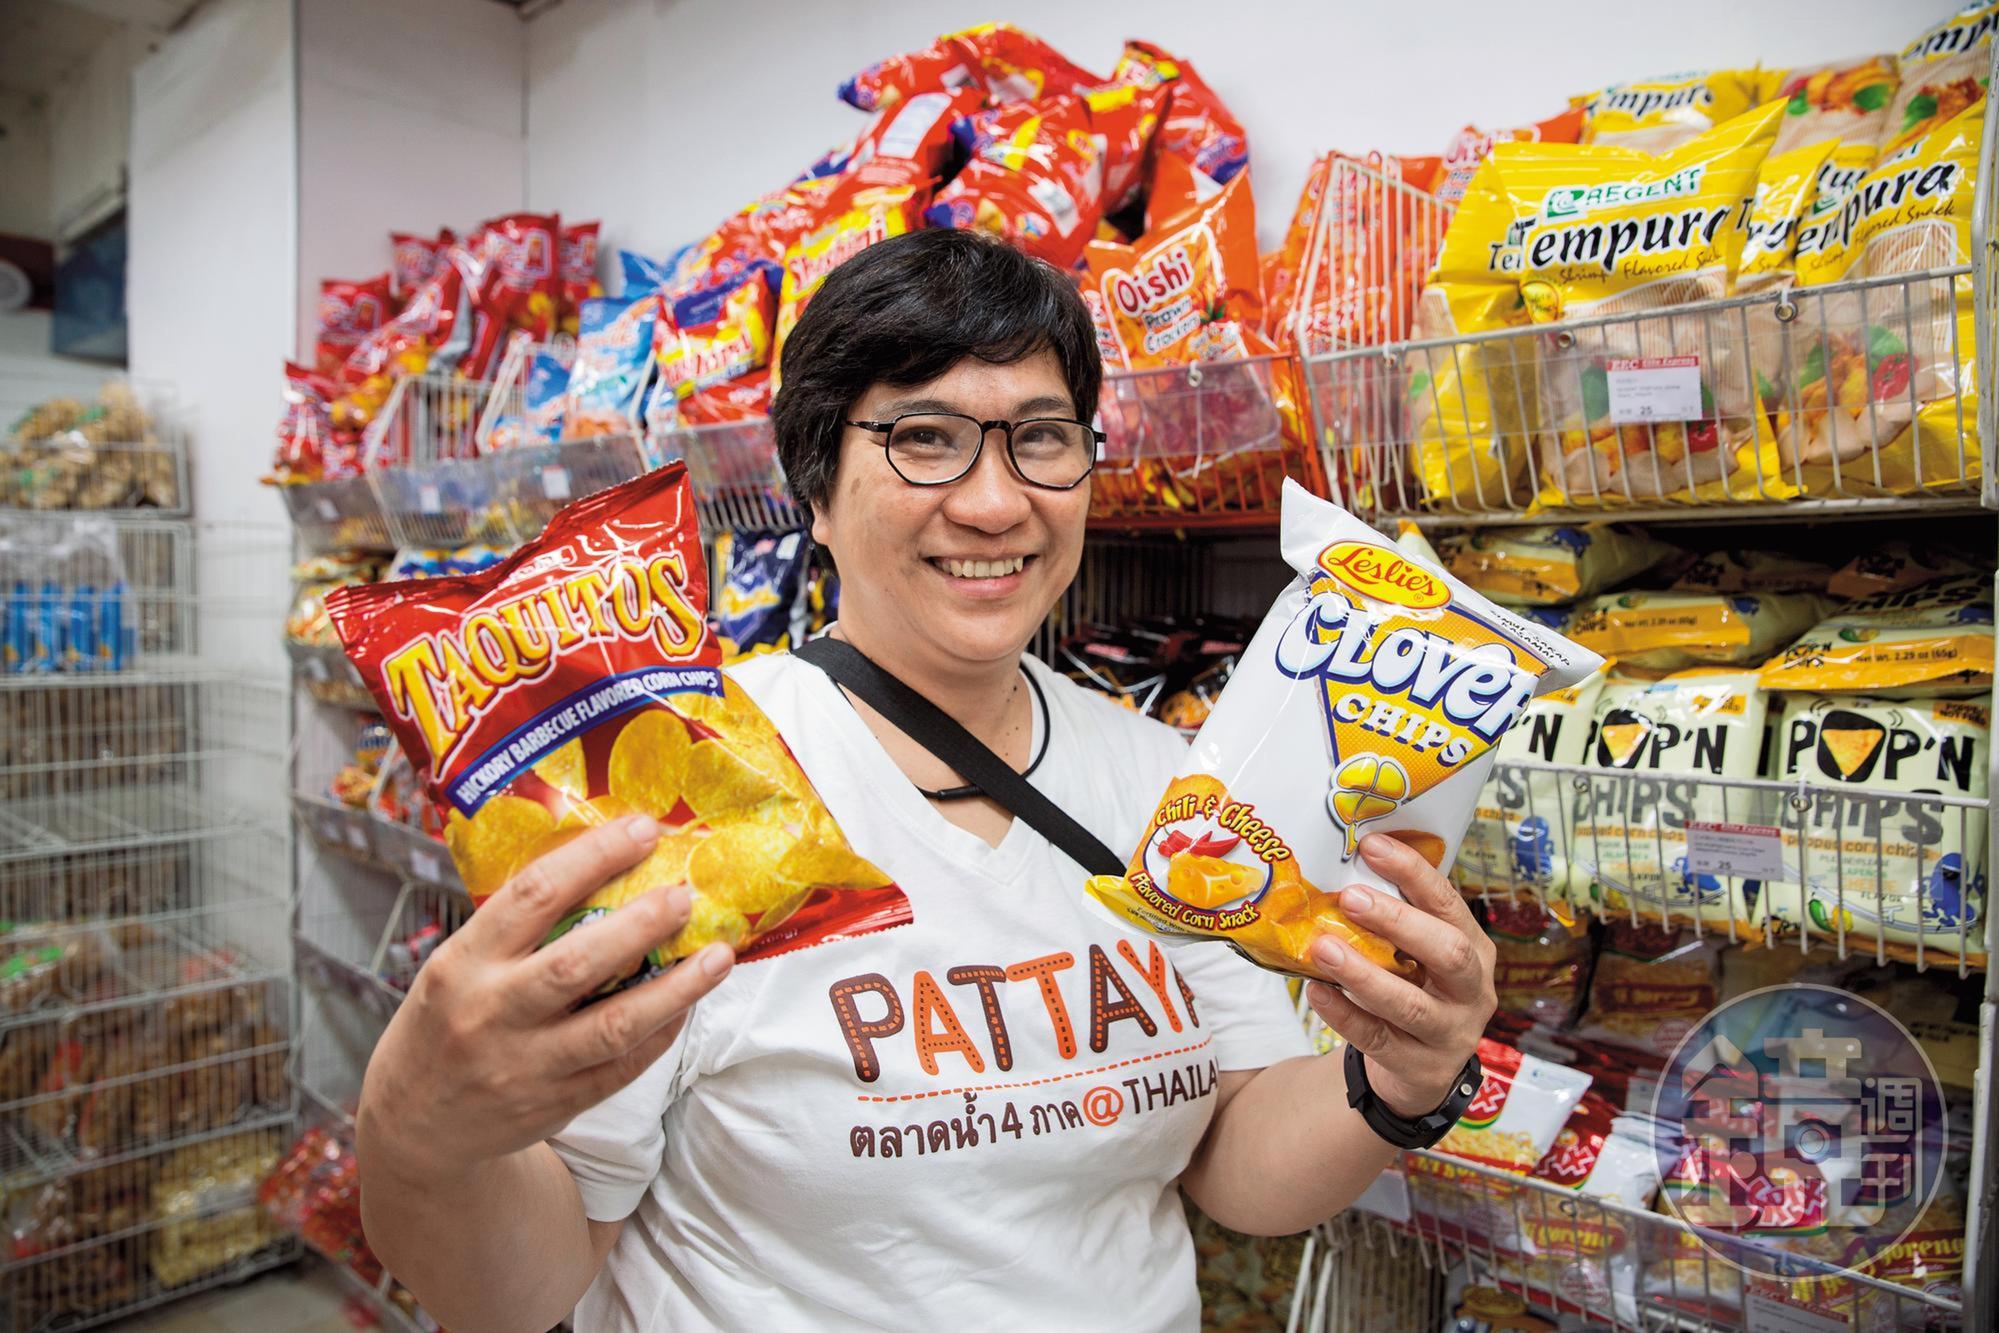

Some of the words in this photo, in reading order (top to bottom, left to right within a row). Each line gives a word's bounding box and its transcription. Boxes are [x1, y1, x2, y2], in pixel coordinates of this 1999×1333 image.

[1586, 168, 1701, 205] REGENT
[1906, 199, 1956, 222] Snack
[1117, 251, 1190, 313] Oishi
[1328, 546, 1438, 597] Leslie's
[382, 551, 707, 783] TAQUITOS
[455, 749, 518, 805] HICKORY
[510, 708, 580, 763] BARBECUE
[575, 678, 642, 722] FLAVORED
[641, 671, 683, 692] CORN
[679, 669, 719, 689] CHIPS
[1332, 692, 1474, 767] CHIPS
[1787, 709, 1975, 792] POP'N
[1218, 802, 1292, 862] Cheese
[1129, 870, 1181, 918] Flavored
[1182, 909, 1216, 930] Corn
[1218, 901, 1259, 930] Snack
